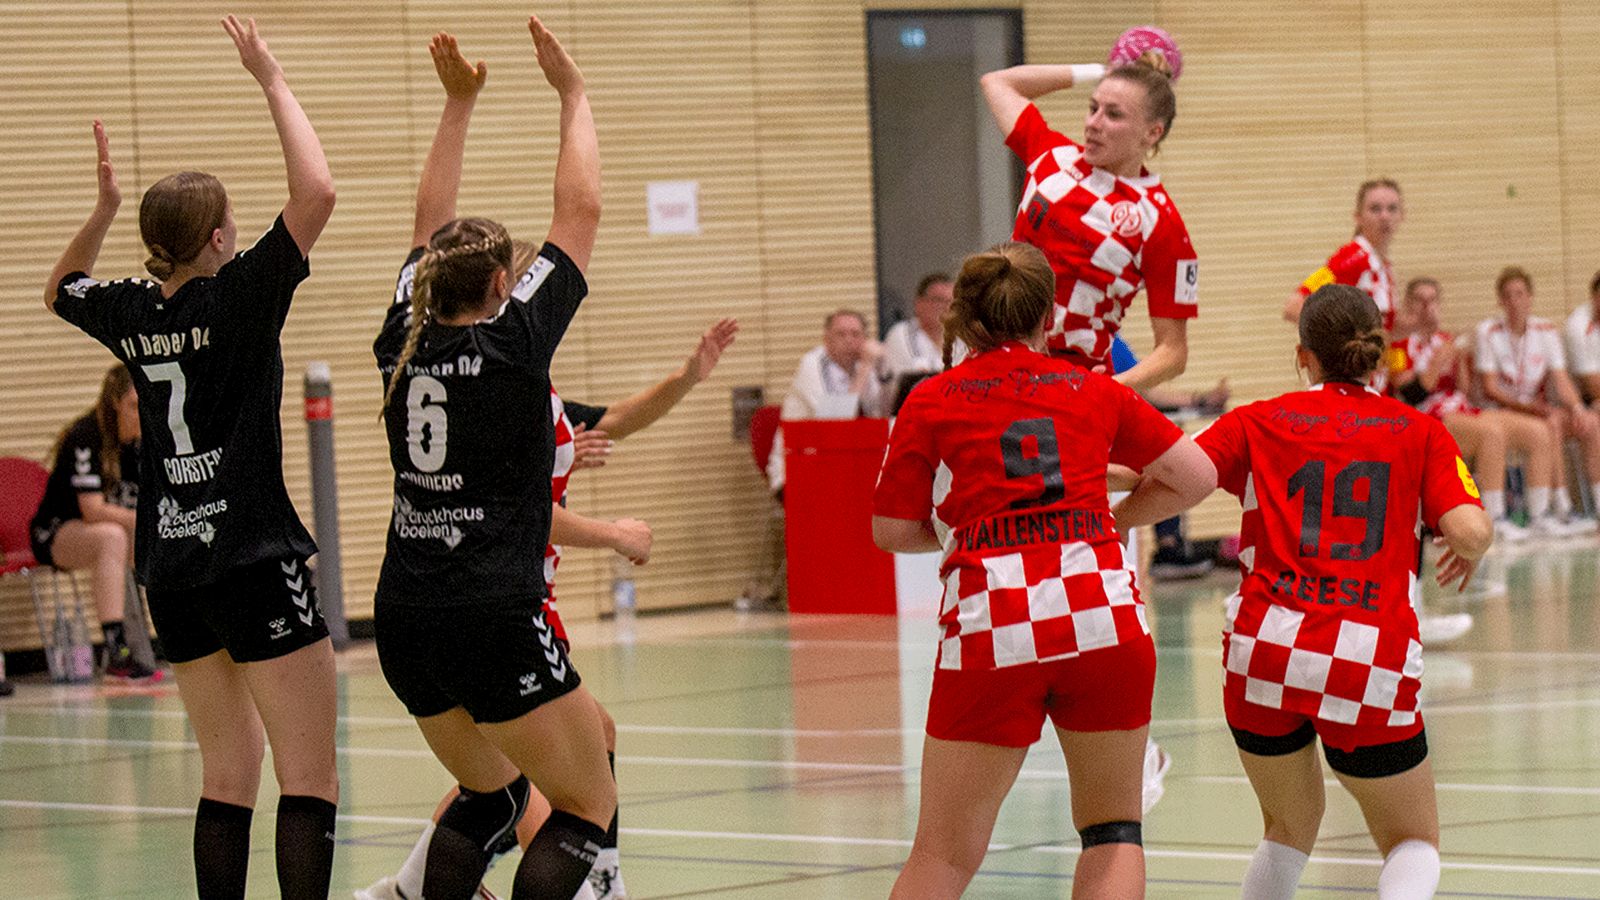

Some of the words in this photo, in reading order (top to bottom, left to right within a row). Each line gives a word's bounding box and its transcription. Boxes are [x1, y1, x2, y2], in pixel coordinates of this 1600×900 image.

[140, 361, 195, 456] 7
[406, 375, 448, 473] 6
[1000, 417, 1066, 510] 9
[1286, 460, 1391, 561] 19
[1271, 569, 1381, 612] REESE
